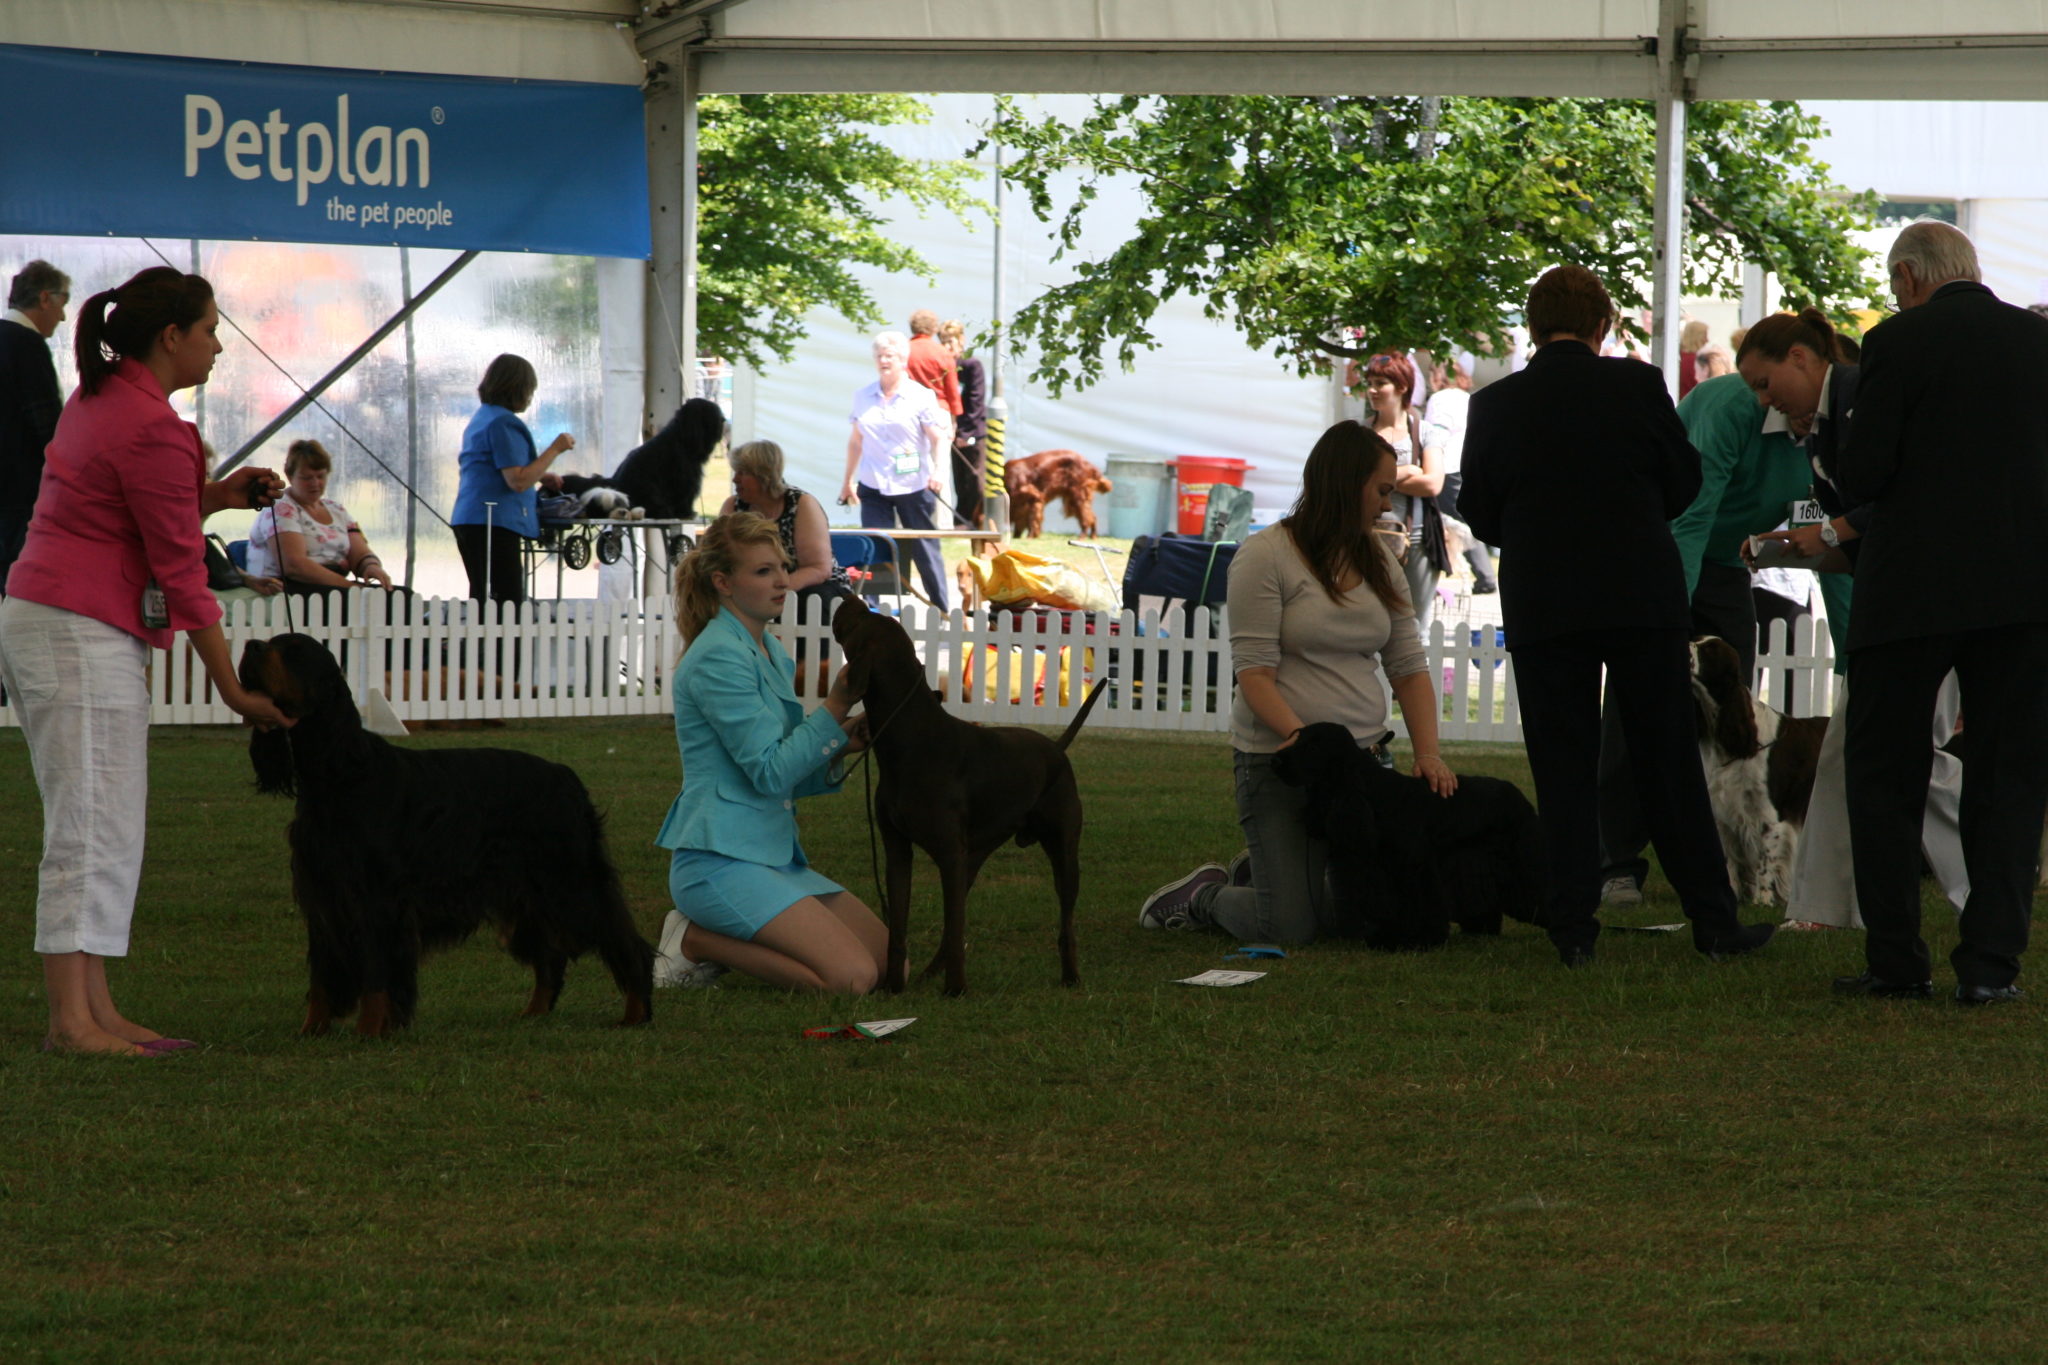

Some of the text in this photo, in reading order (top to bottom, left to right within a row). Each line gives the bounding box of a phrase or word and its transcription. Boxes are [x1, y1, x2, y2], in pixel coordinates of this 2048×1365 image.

[185, 93, 430, 206] Petplan
[326, 196, 453, 231] the pet people
